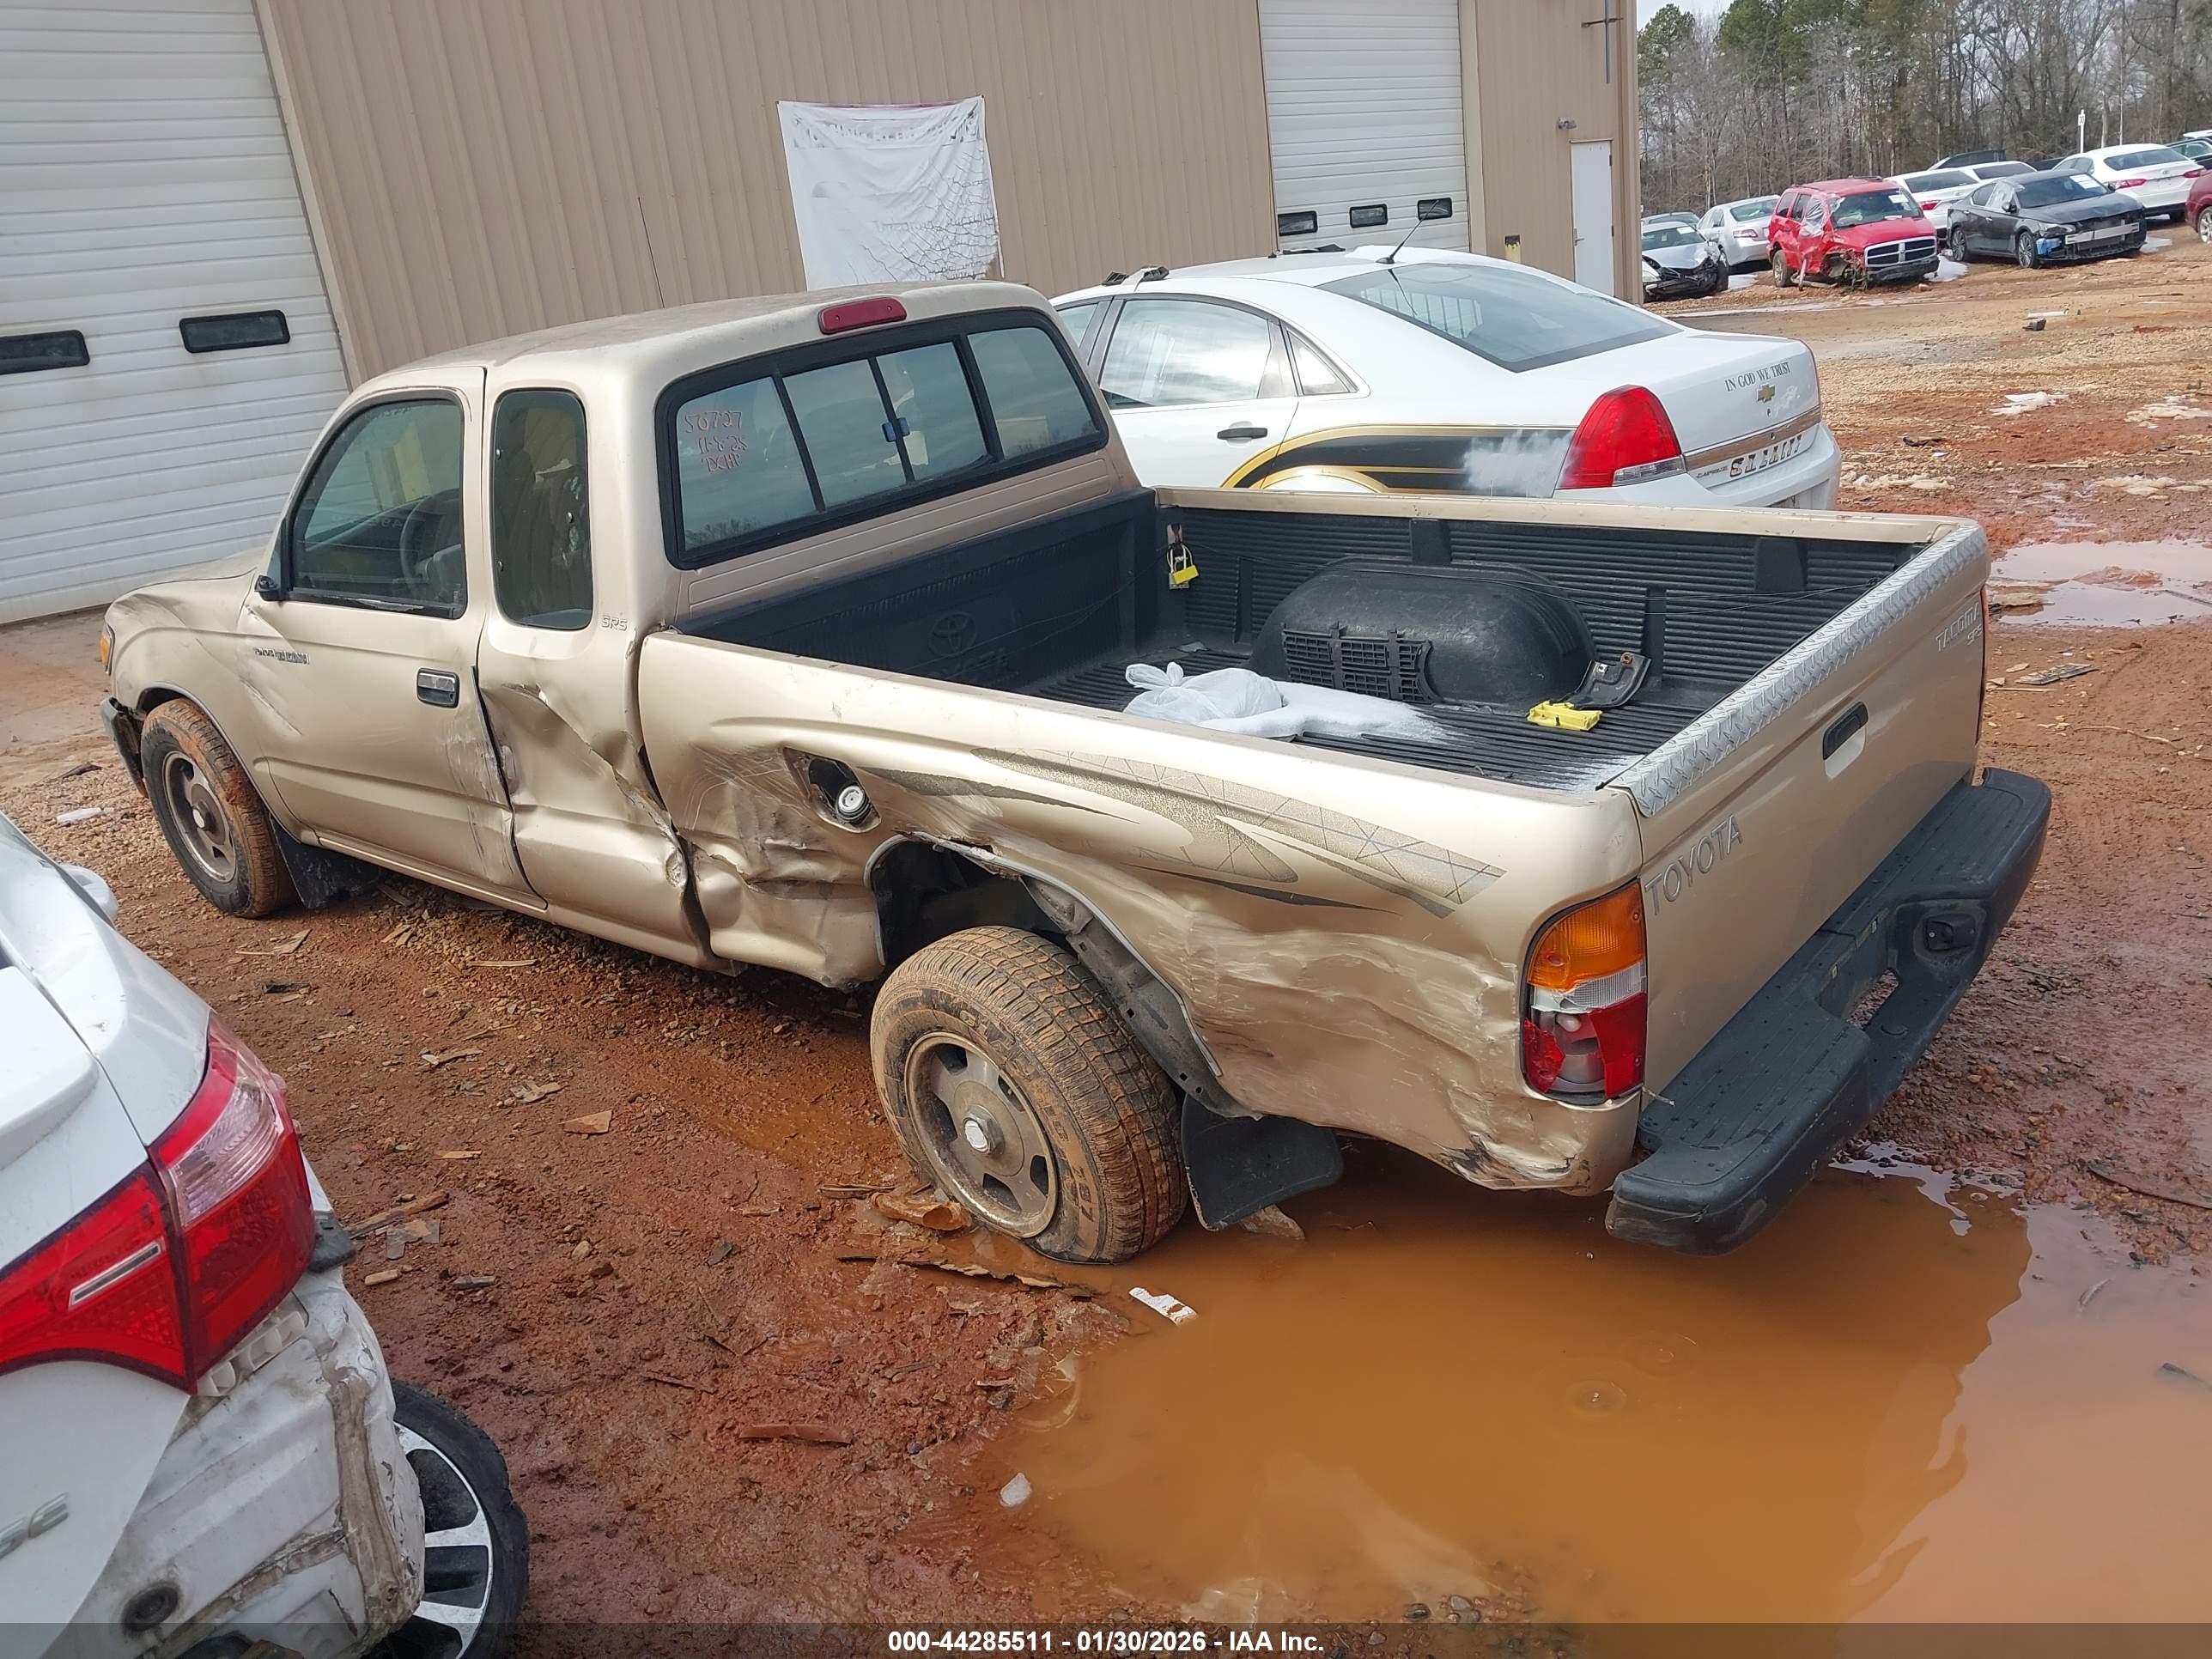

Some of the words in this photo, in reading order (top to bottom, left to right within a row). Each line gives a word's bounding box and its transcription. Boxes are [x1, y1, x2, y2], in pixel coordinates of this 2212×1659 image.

[1724, 378, 1737, 392] IN
[1737, 371, 1756, 388] GOD
[1756, 368, 1771, 382] WE
[1770, 362, 1791, 379] TRUST
[1935, 601, 1980, 652] TACOMA
[1644, 813, 1743, 916] TOYOTA
